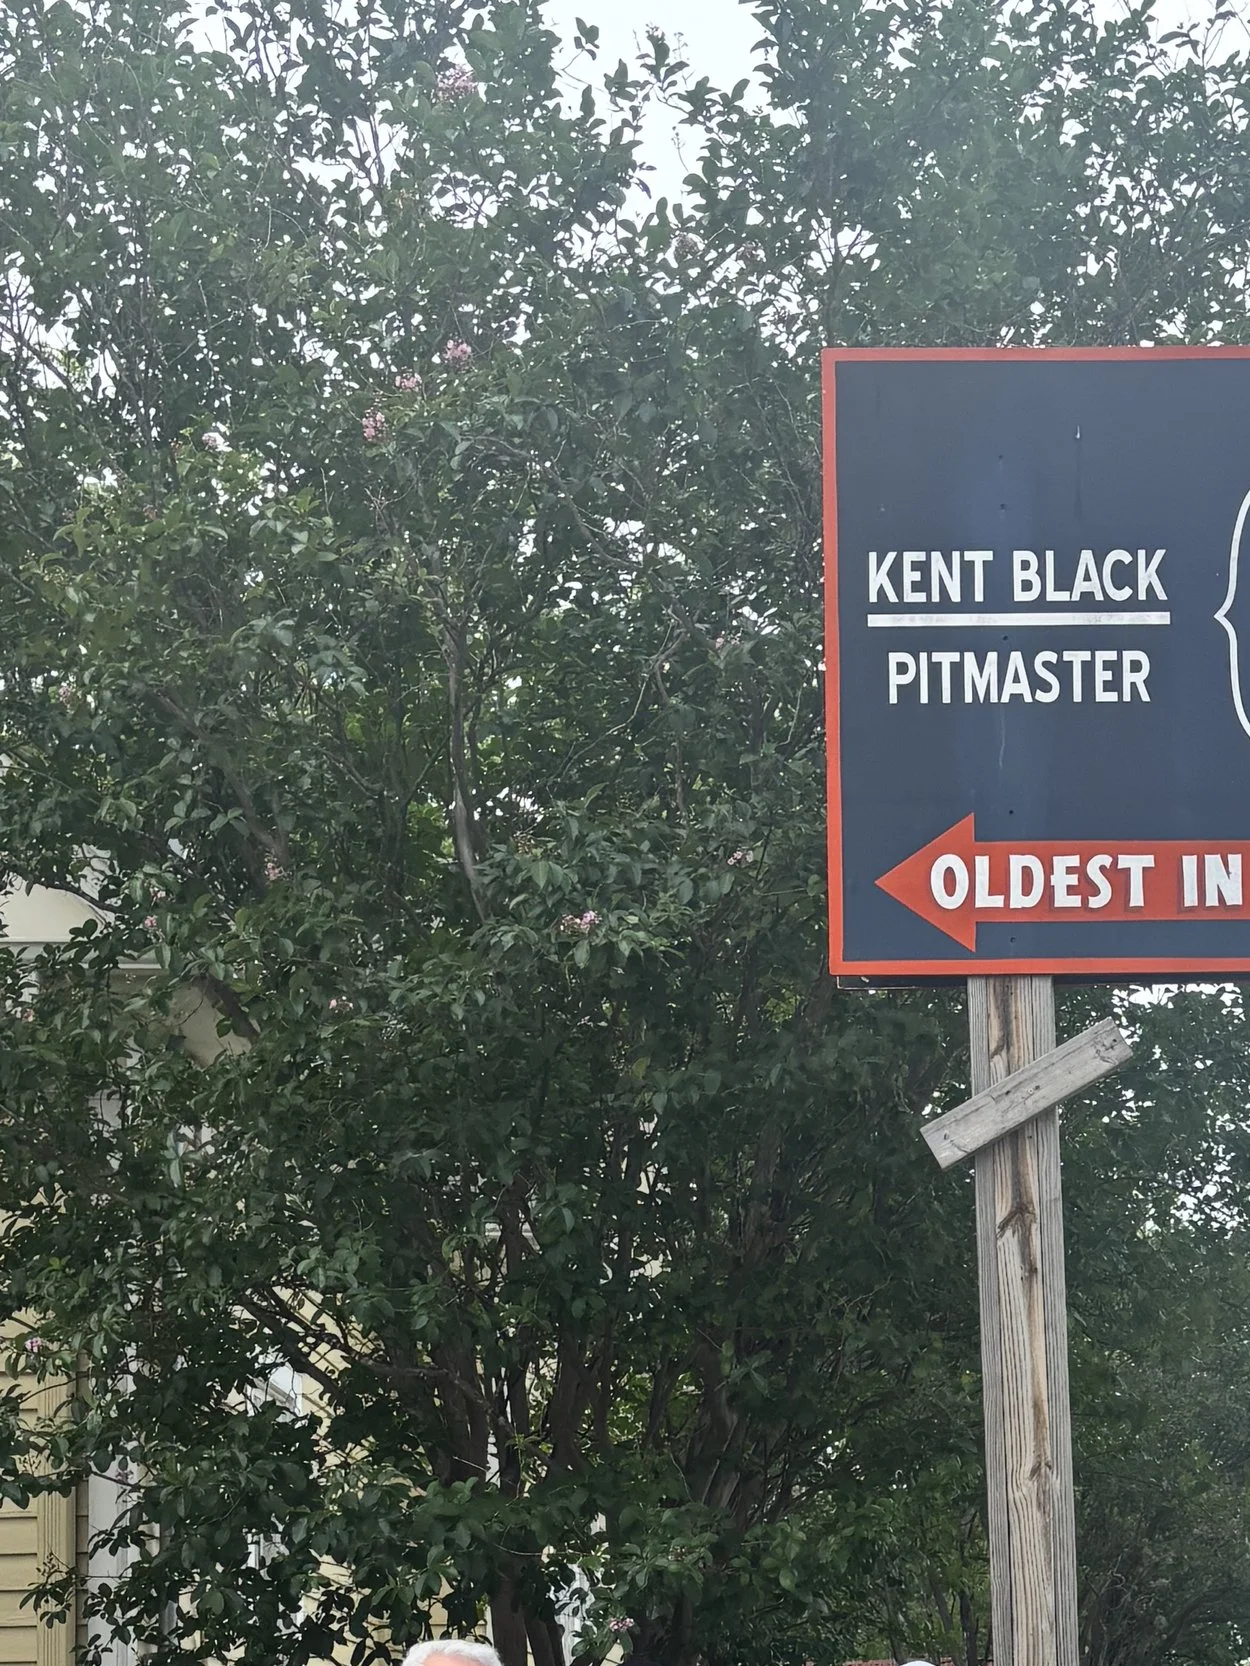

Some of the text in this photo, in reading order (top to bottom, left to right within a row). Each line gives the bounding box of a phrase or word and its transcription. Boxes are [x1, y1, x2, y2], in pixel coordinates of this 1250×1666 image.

[867, 548, 1169, 604] KENT BLACK
[887, 650, 1153, 704] PITMASTER
[929, 853, 1155, 912] OLDEST
[1181, 853, 1244, 907] IN
